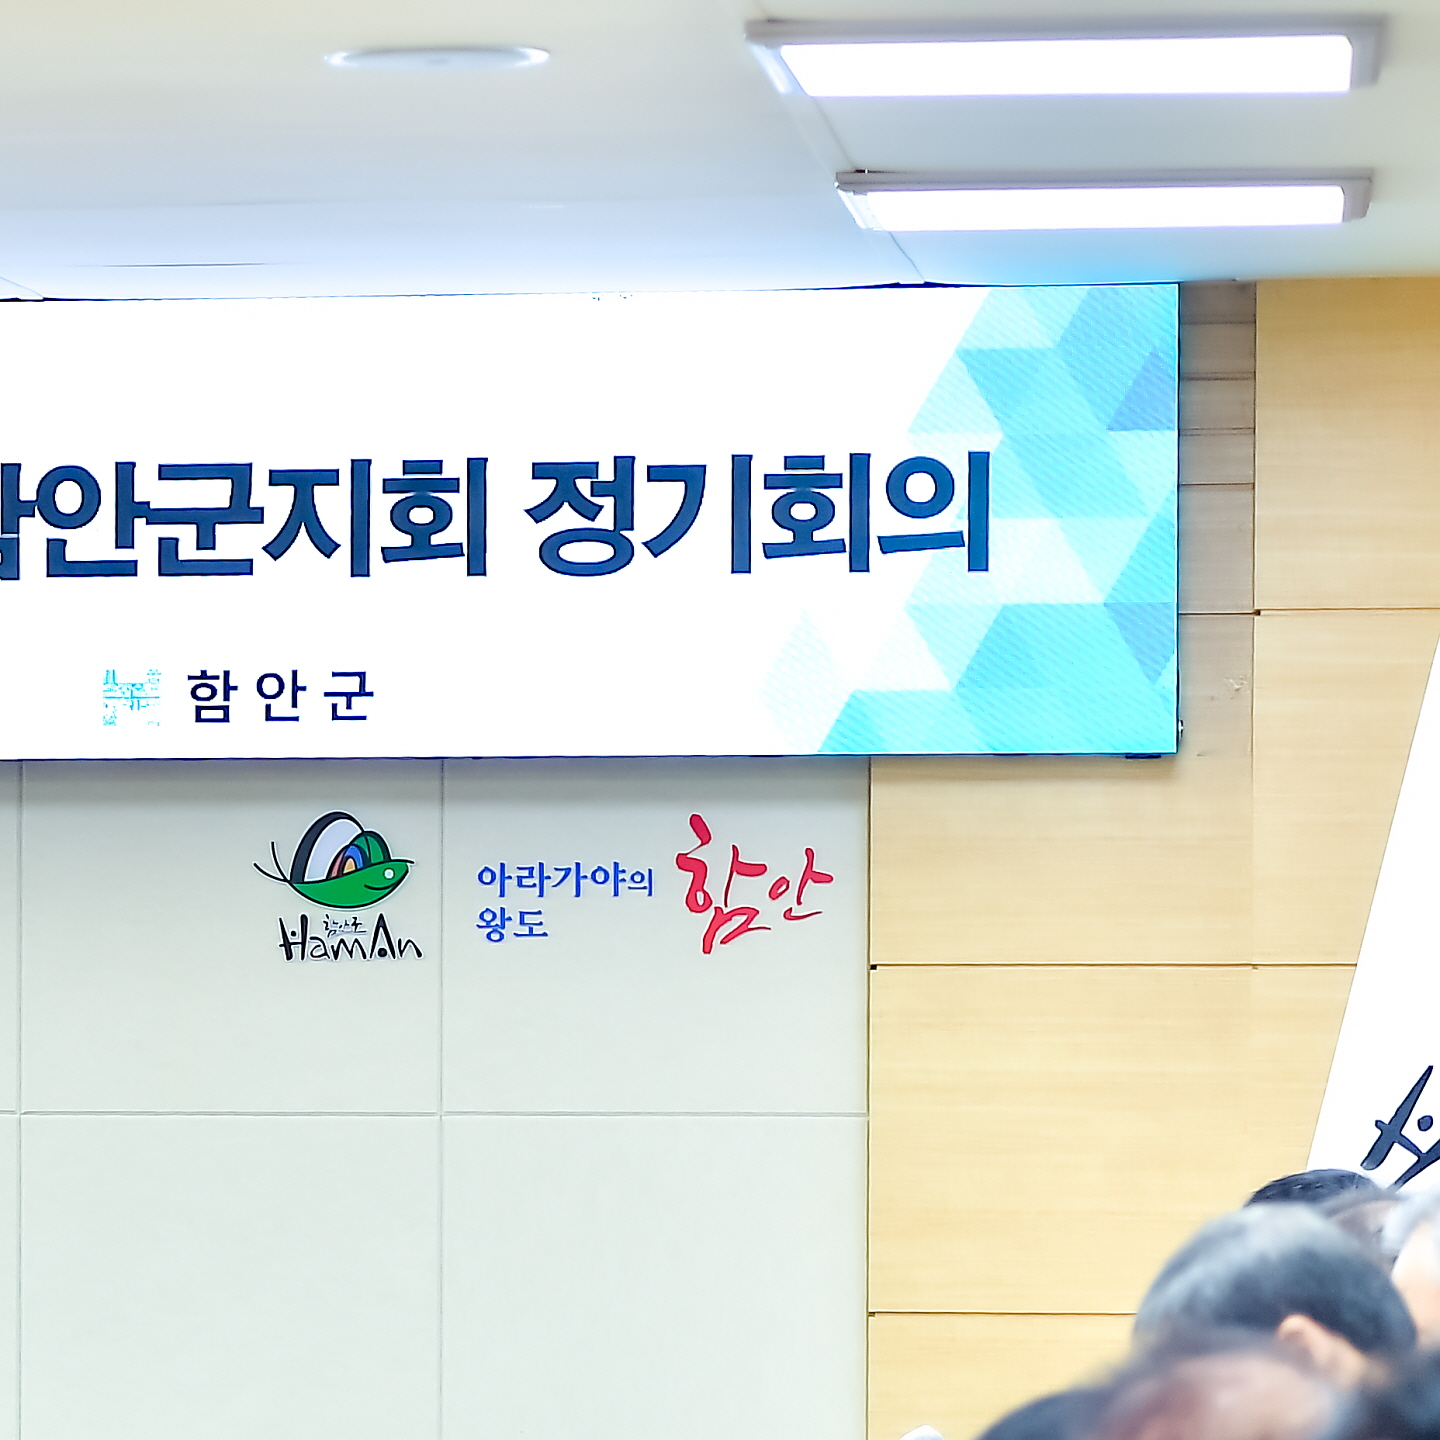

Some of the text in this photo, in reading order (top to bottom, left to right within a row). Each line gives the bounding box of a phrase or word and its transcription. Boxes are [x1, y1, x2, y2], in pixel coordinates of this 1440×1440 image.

[523, 450, 991, 578] 정기회의
[477, 861, 654, 898] 아라가야의
[675, 813, 834, 955] 함안
[476, 906, 549, 943] 왕도
